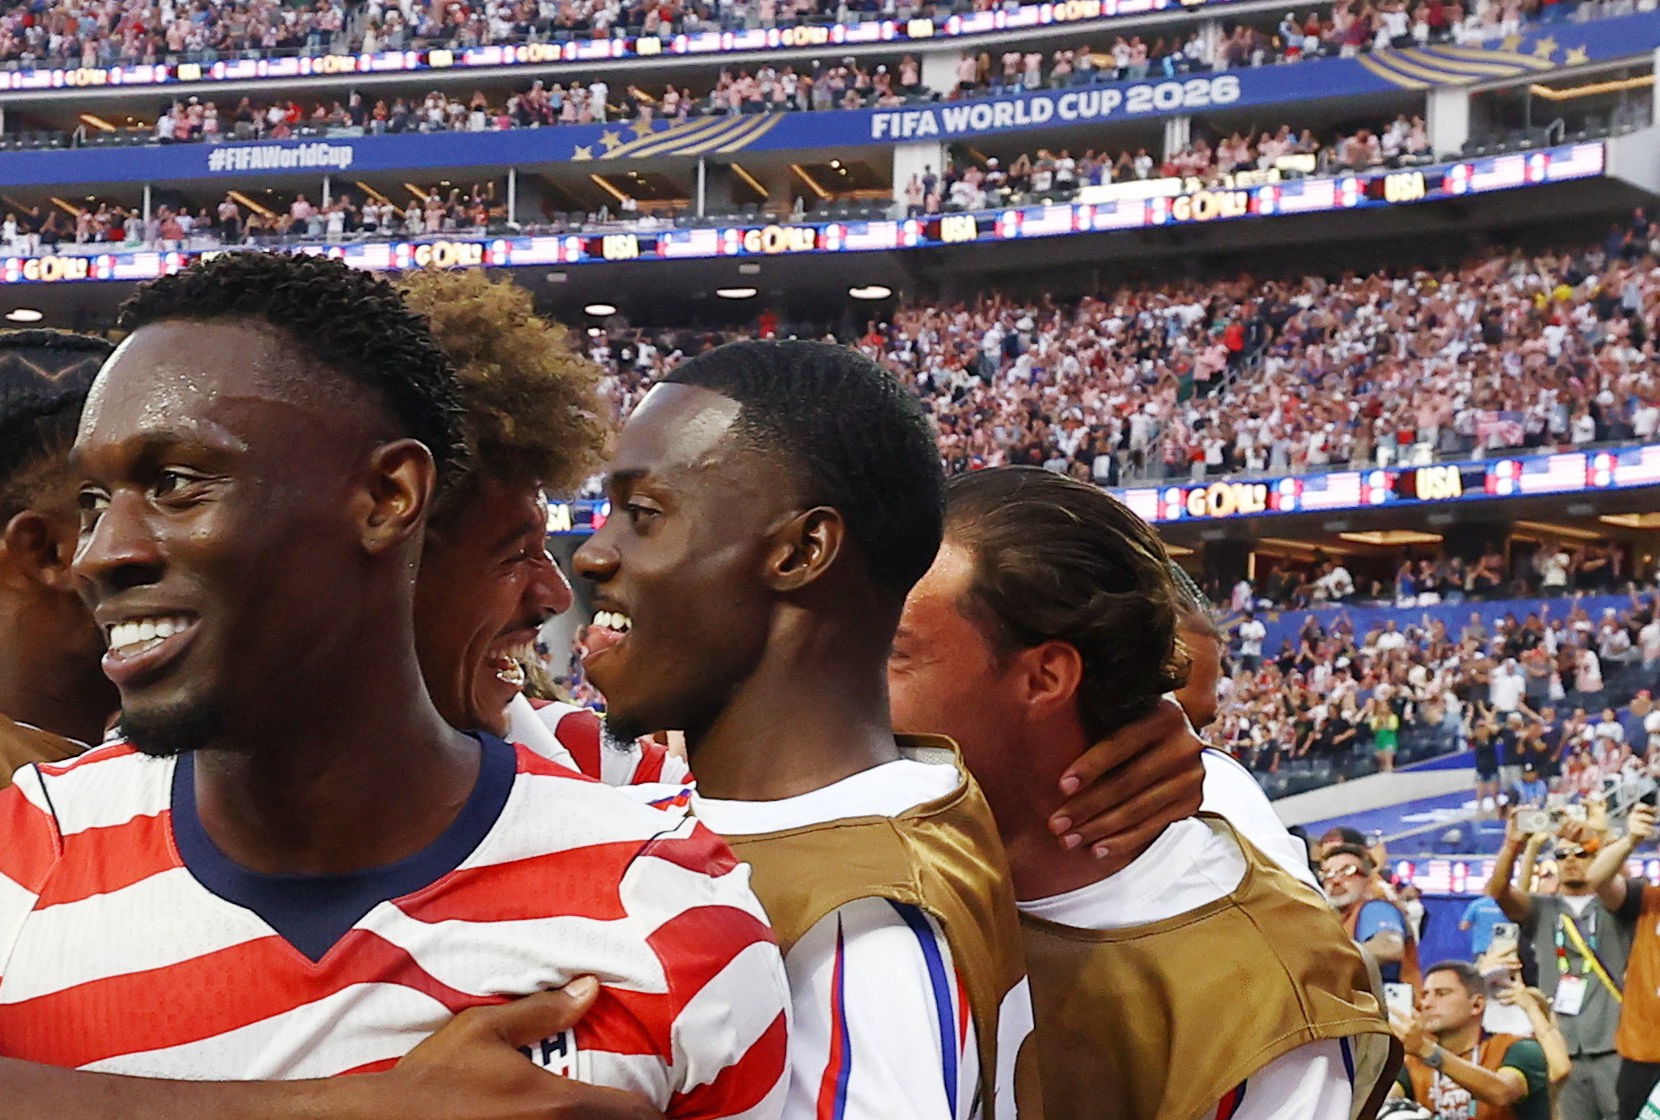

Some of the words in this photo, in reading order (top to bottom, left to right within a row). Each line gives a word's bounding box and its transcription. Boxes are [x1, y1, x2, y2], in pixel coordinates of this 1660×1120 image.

[870, 110, 939, 139] FIFA
[942, 97, 1054, 133] WORLD
[1058, 89, 1122, 120] CUP
[1125, 75, 1240, 113] 2026
[208, 142, 353, 170] #FIFAWorldCup
[602, 234, 639, 260] USA
[940, 214, 978, 243] USA
[1384, 171, 1426, 202] USA
[1416, 464, 1463, 500] USA
